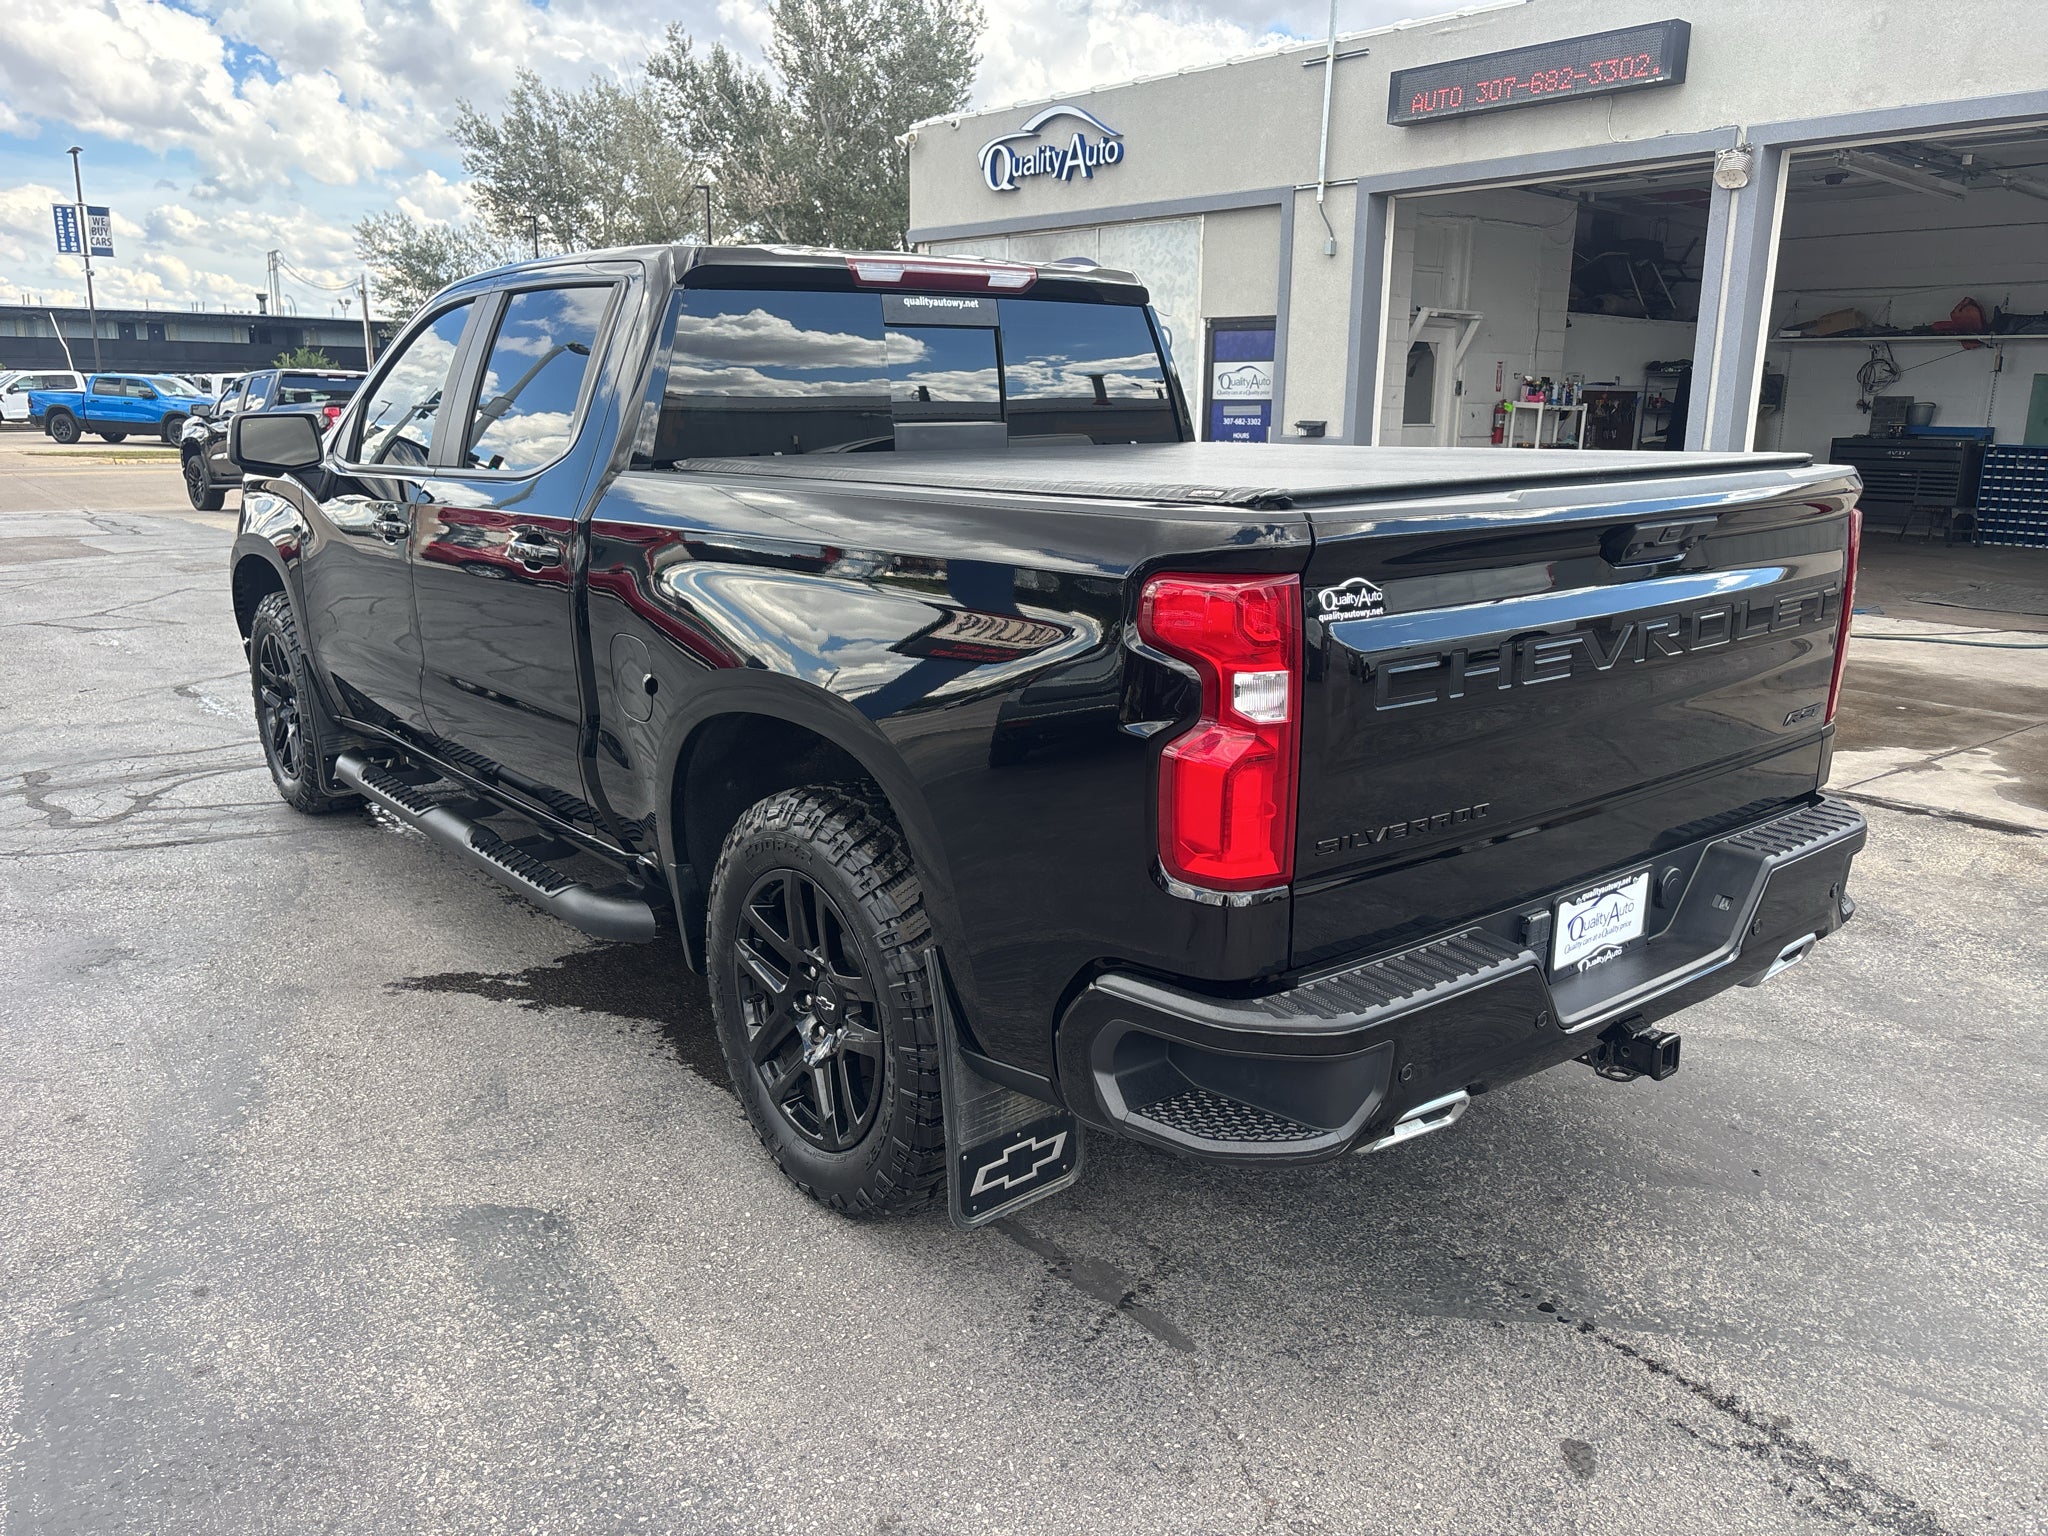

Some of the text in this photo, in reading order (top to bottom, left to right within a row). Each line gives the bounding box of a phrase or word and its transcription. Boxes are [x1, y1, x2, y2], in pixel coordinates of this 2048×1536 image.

[1410, 86, 1463, 114] AUTO
[92, 217, 105, 226] WE
[91, 226, 109, 236] BUY
[91, 237, 112, 247] CARS
[903, 296, 979, 309] qualityautowy.net
[1318, 607, 1384, 623] qualityautowy.net
[1374, 582, 1837, 711] CHEVROLET
[1315, 802, 1490, 857] SILVERADO
